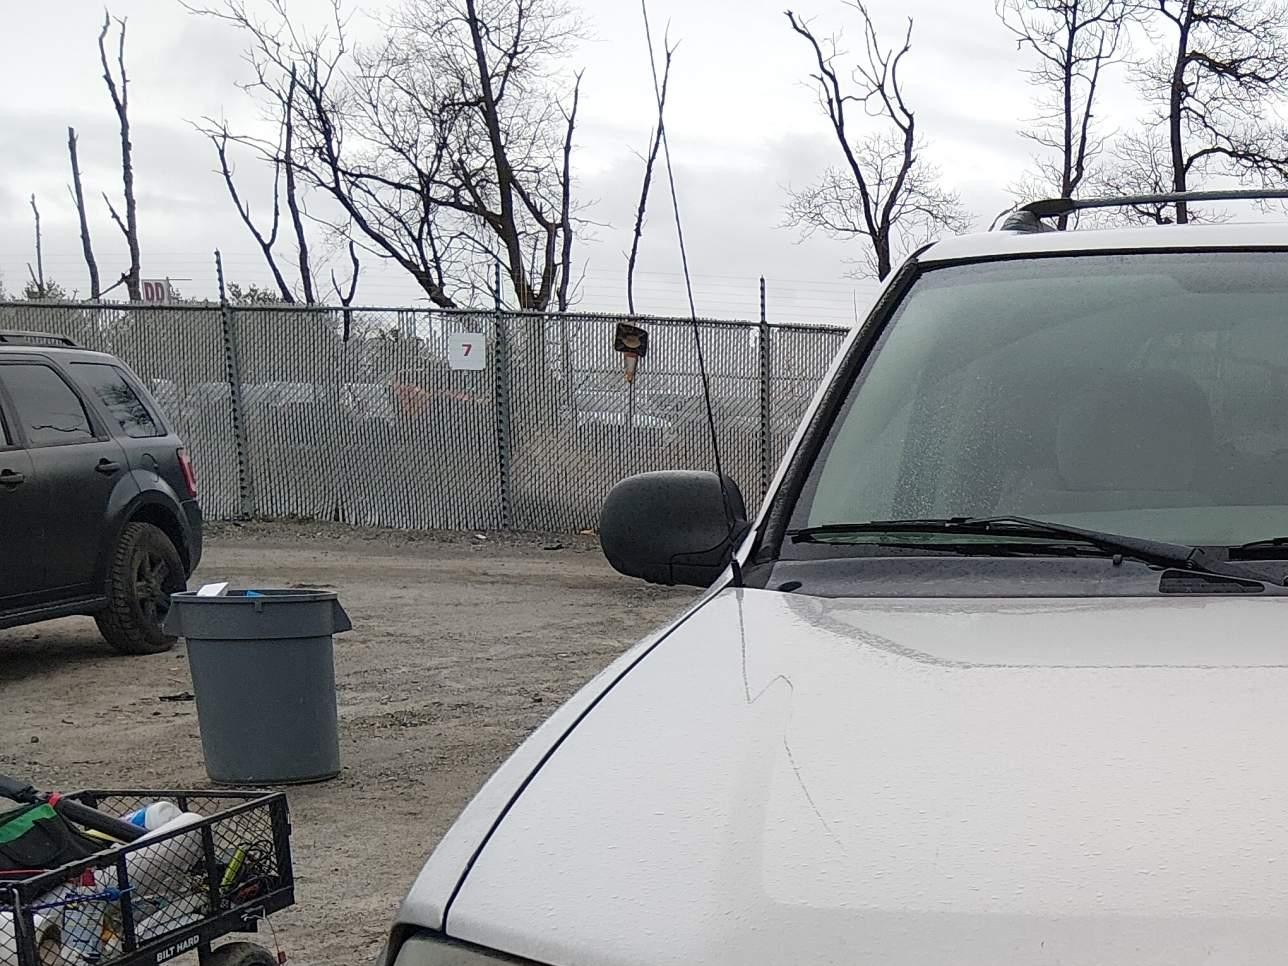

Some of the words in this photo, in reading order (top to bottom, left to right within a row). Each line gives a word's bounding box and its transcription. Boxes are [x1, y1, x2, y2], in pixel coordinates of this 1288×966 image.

[462, 343, 472, 357] 7
[156, 945, 175, 963] BILT
[176, 934, 200, 953] HARD
